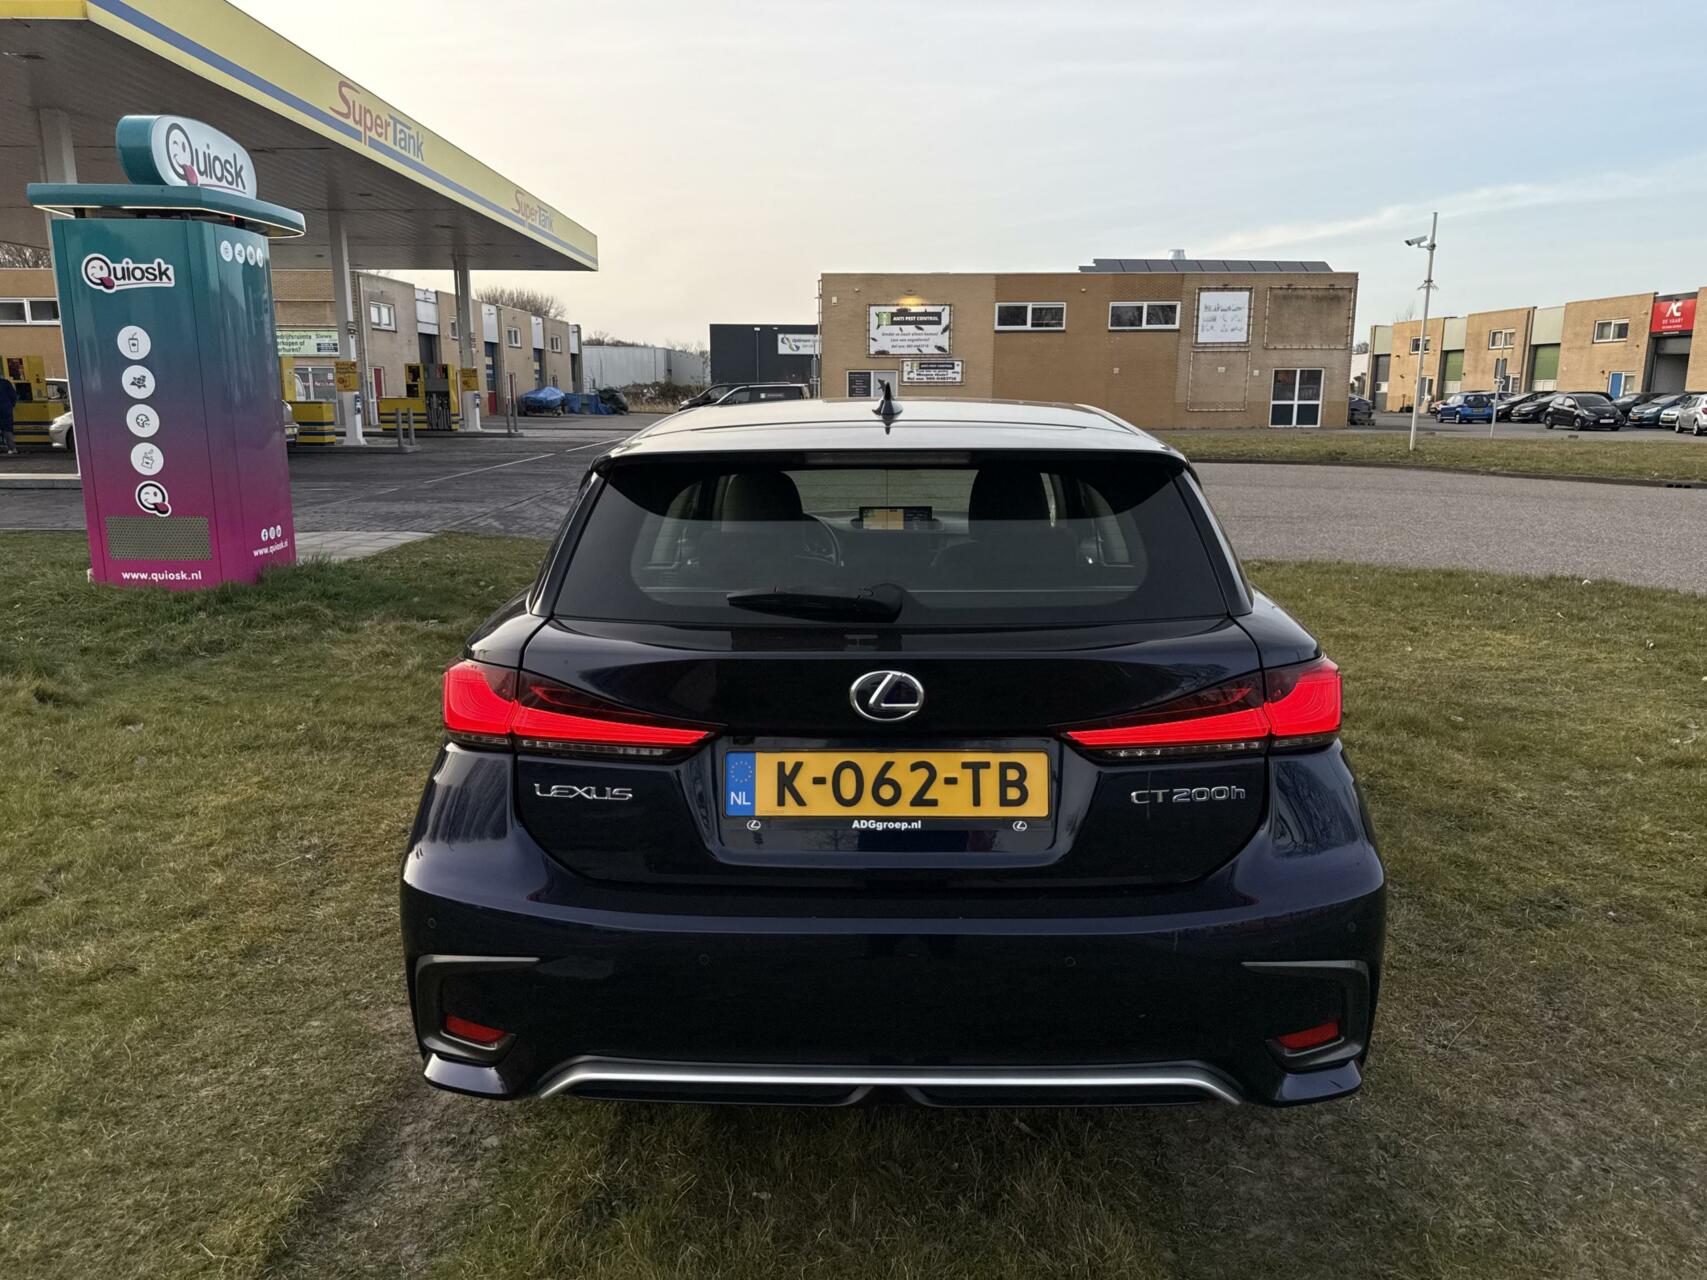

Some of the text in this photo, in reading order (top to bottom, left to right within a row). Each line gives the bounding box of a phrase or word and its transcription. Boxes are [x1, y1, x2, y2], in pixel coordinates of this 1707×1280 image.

[329, 80, 425, 162] SuperTank
[166, 123, 247, 191] Quiosk
[511, 189, 555, 234] SuperTank
[84, 256, 173, 288] Quiosk
[121, 568, 202, 583] www.quiosk.nl
[533, 783, 633, 801] LEXUS
[776, 760, 1029, 808] K-062-TB
[1130, 785, 1246, 804] CT200h
[730, 791, 751, 806] NL
[851, 819, 922, 832] ADGgroep.nl
